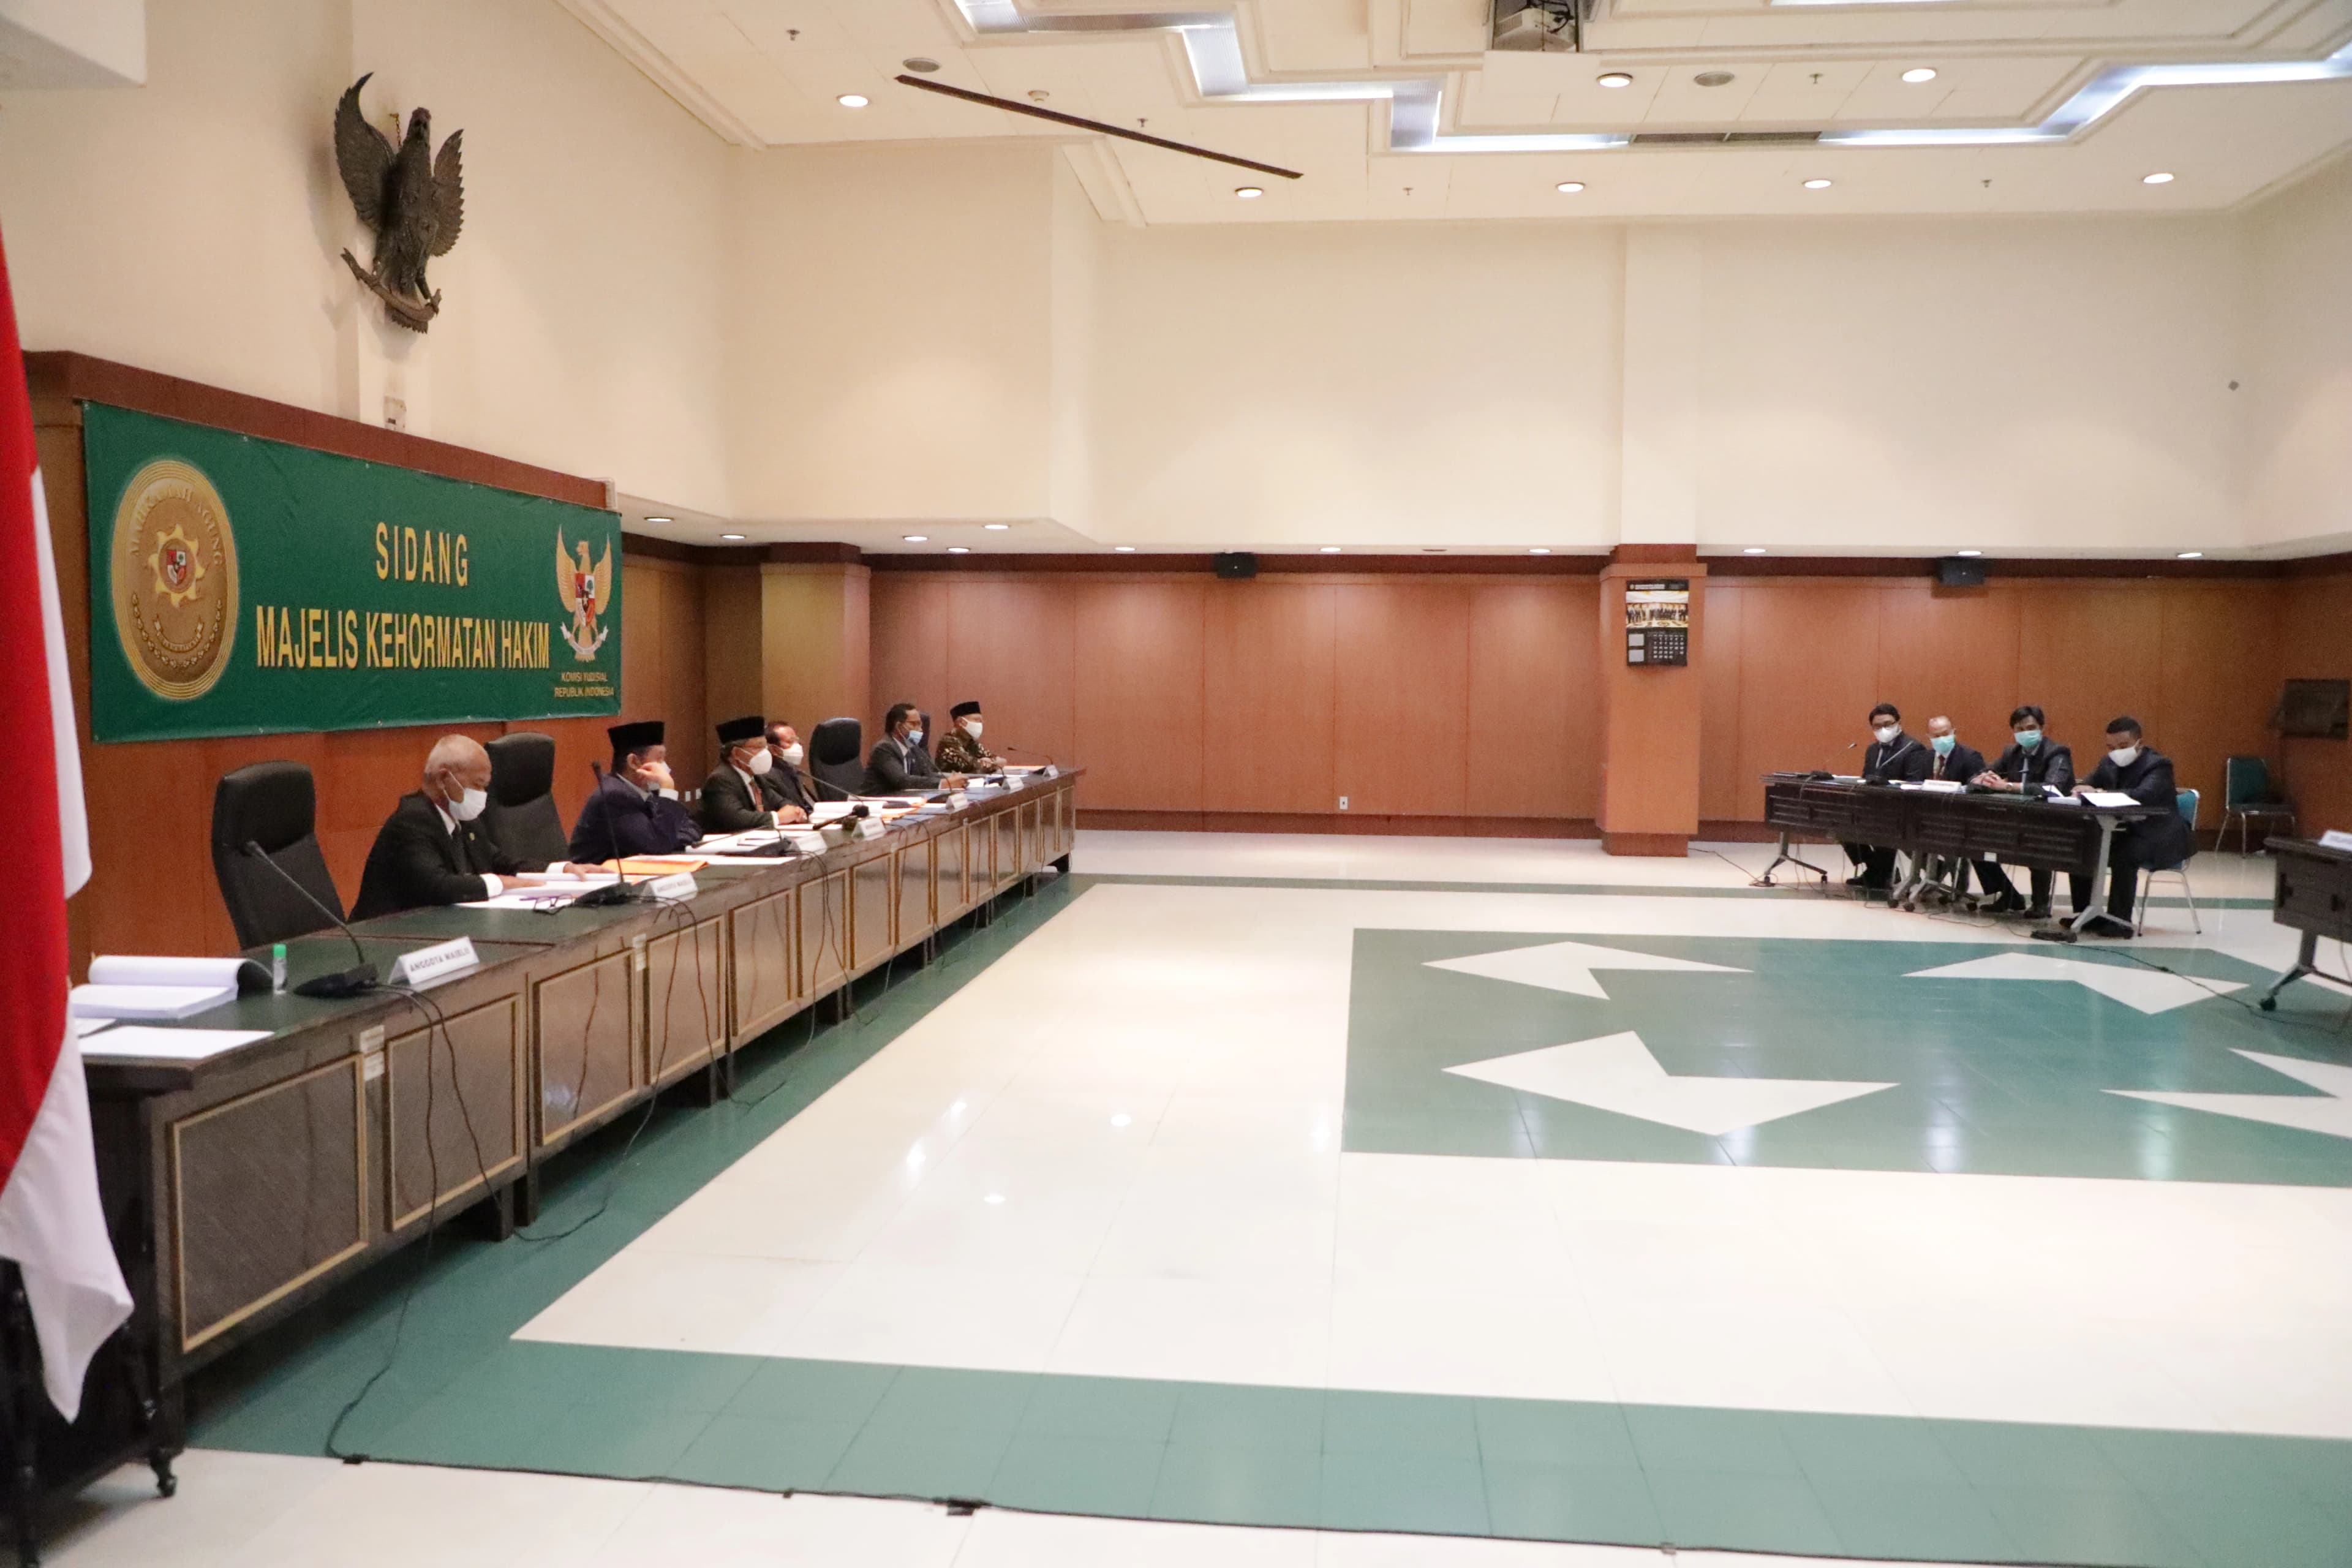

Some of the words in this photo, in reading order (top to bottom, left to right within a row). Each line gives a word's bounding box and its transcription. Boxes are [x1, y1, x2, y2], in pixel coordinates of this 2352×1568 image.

[375, 522, 469, 587] SIDANG
[256, 605, 359, 669] MAJELIS
[366, 611, 496, 669] KEHORMATAN
[501, 620, 549, 669] HAKIM
[554, 687, 584, 697] REPUBLIK
[584, 686, 614, 696] INDONESIA
[561, 671, 582, 682] KOMISI
